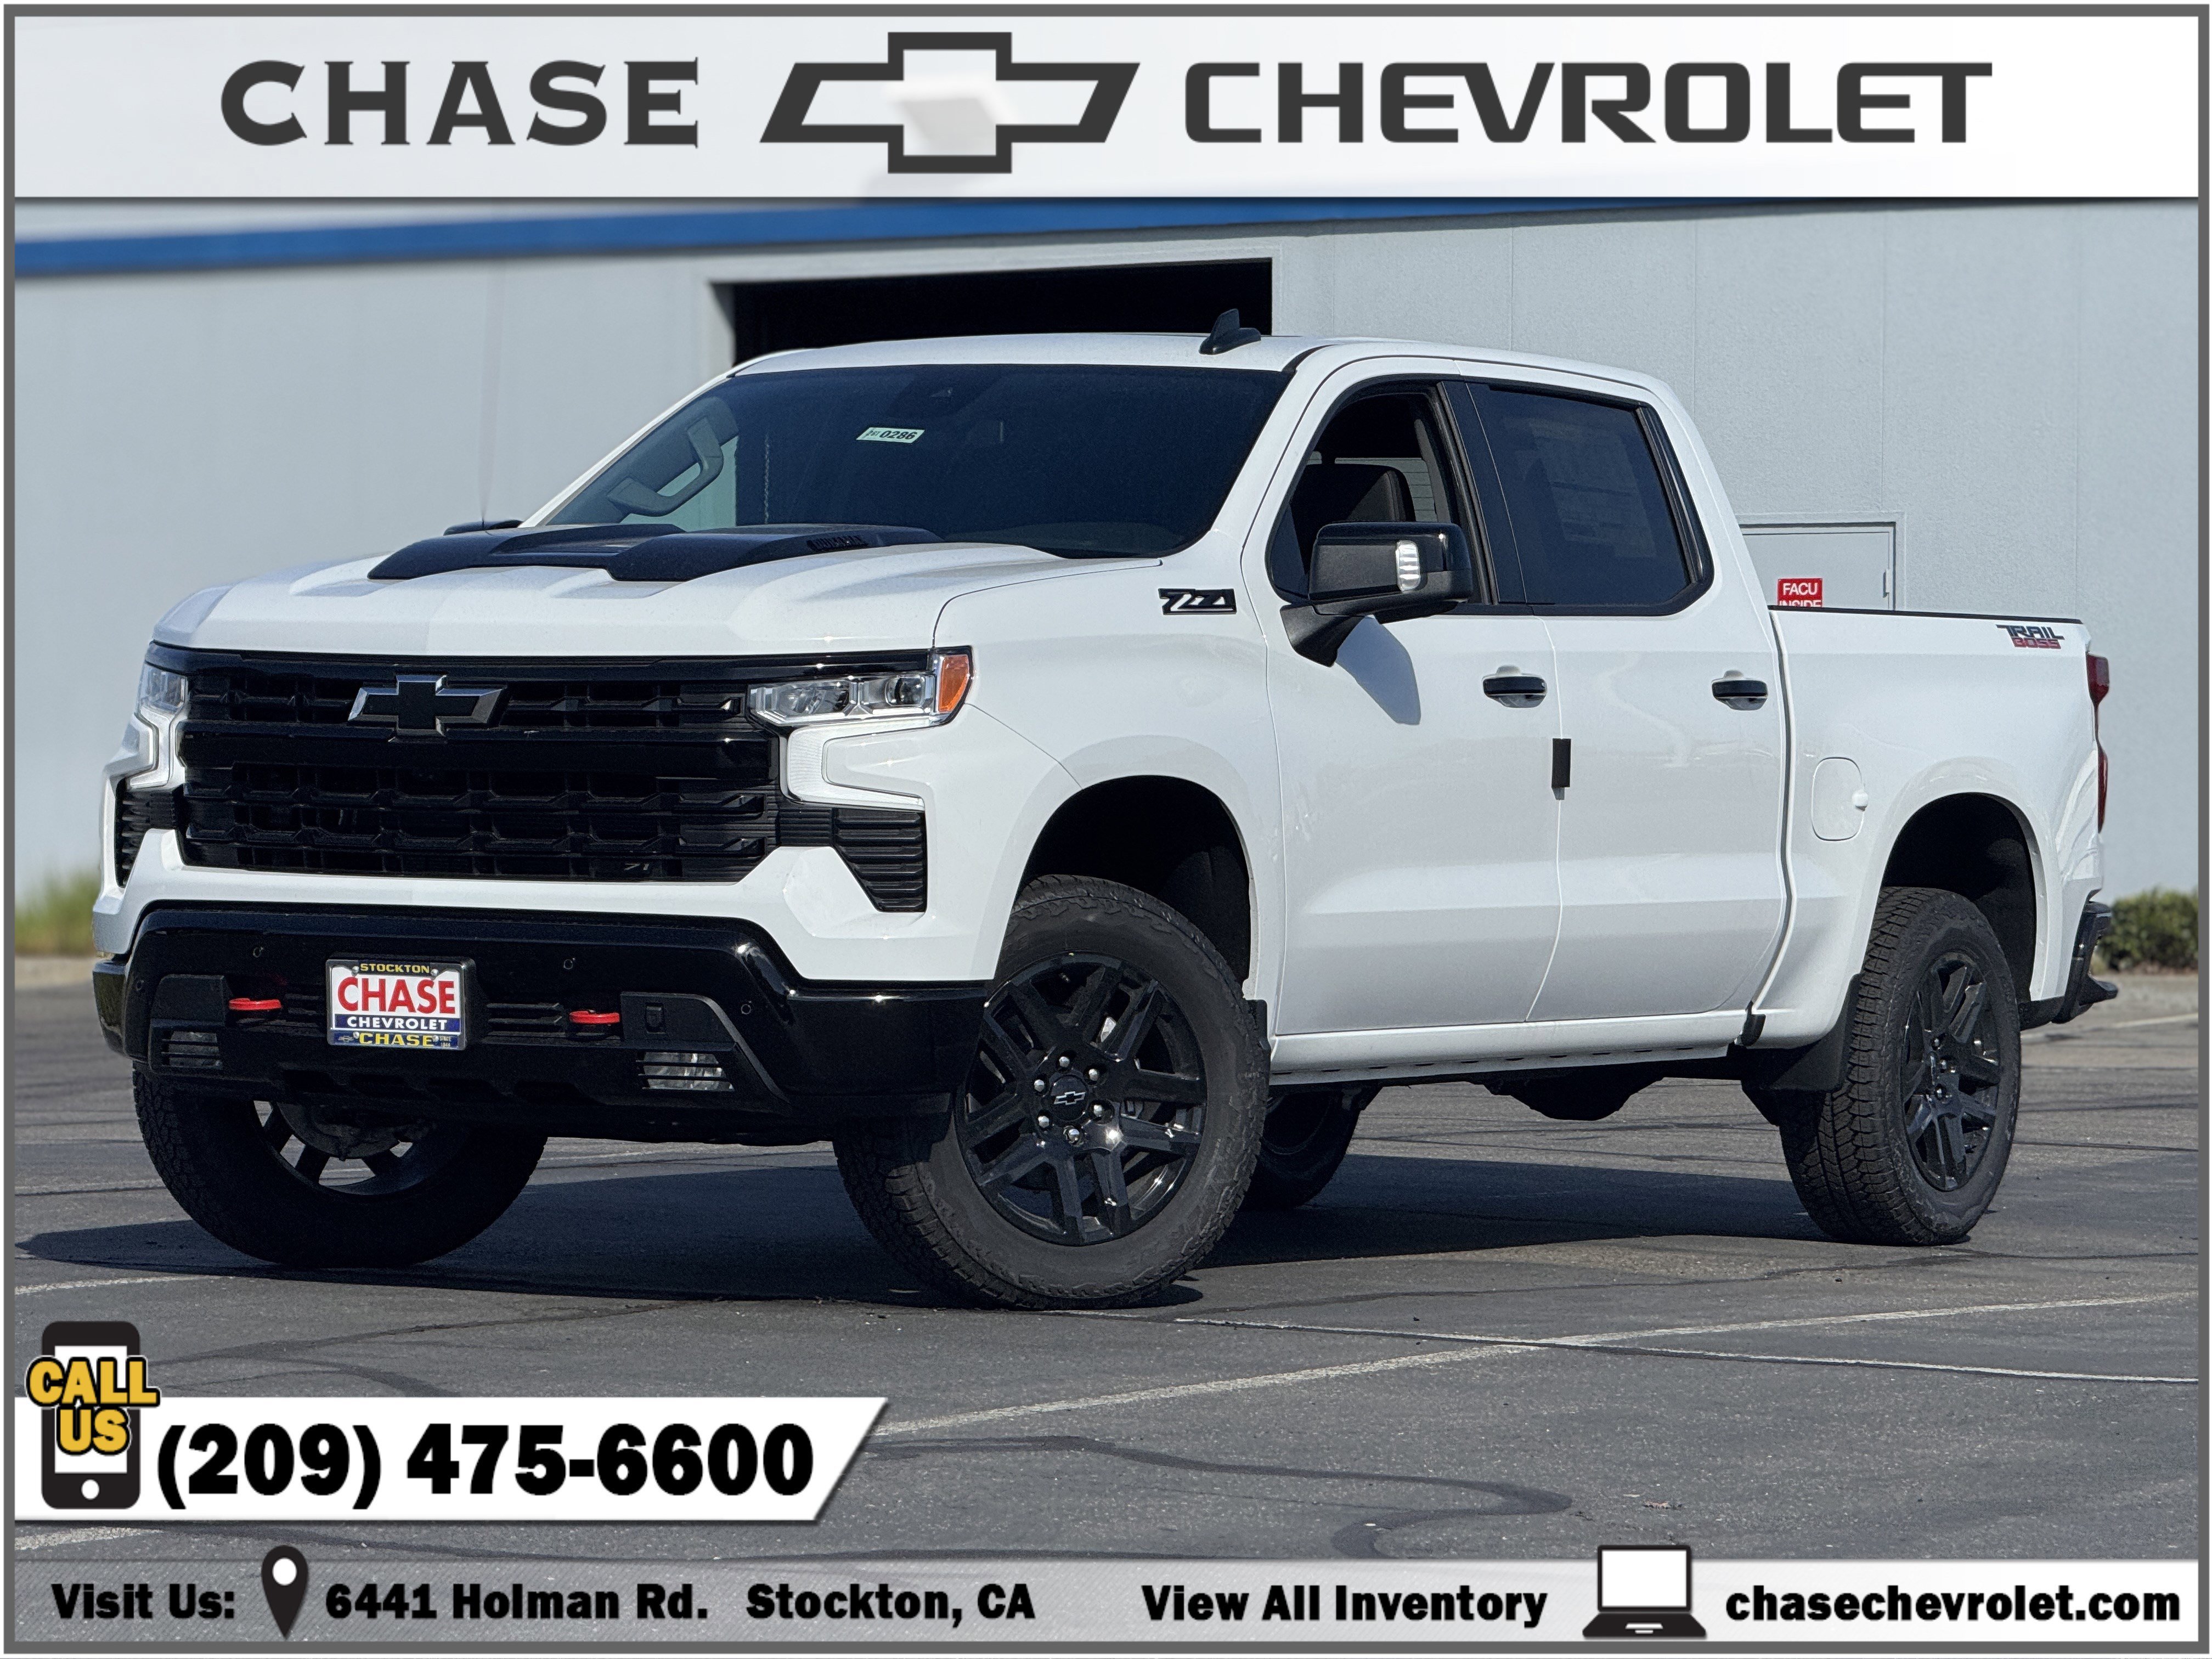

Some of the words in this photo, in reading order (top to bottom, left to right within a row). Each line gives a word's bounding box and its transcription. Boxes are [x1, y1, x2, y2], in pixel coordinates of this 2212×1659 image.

[879, 431, 917, 440] 0286
[1782, 583, 1818, 596] FACU
[1995, 624, 2065, 640] TRAIL
[2012, 637, 2061, 649] BOSS
[360, 963, 430, 973] STOCKTON
[337, 977, 455, 1014] CHASE
[347, 1016, 447, 1030] CHEVROLET
[359, 1032, 434, 1047] CHASE
